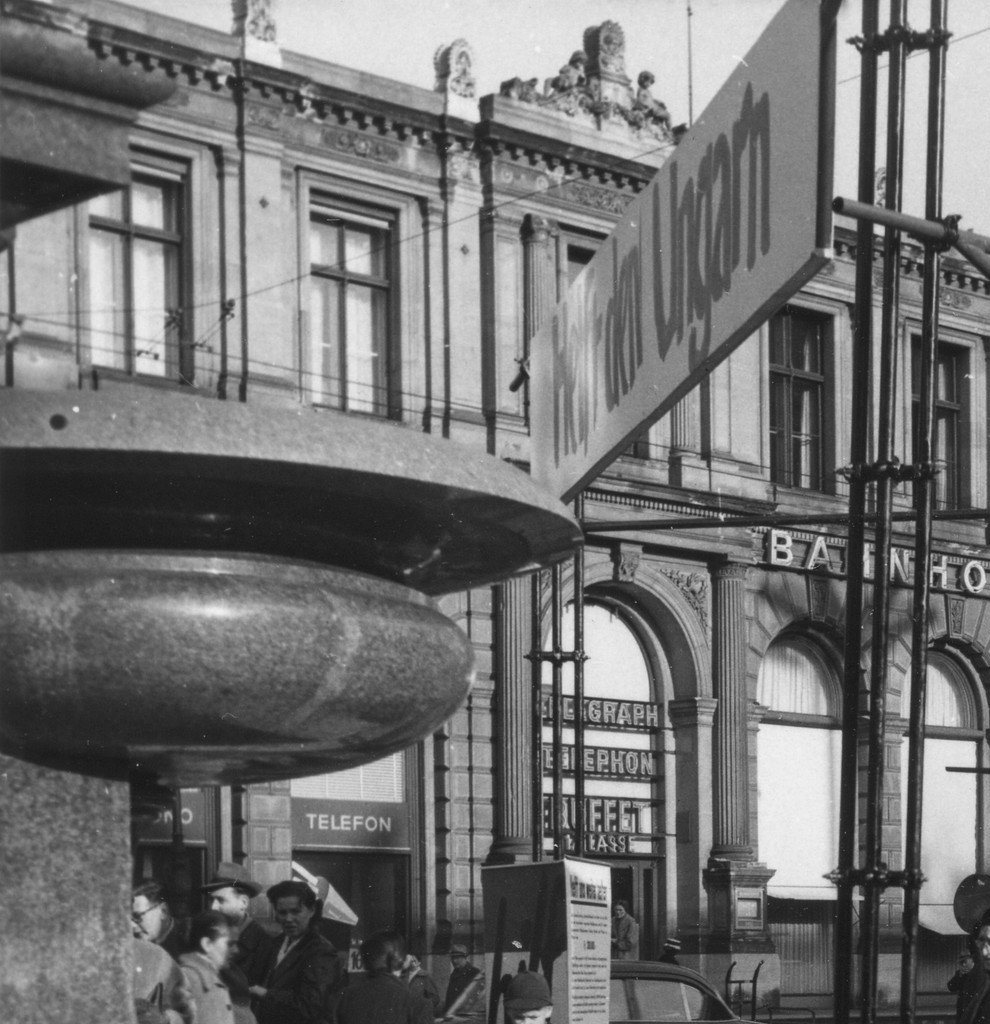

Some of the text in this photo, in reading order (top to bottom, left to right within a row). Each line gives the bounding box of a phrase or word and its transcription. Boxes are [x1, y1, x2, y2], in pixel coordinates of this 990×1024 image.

[604, 236, 643, 413] den
[652, 81, 771, 374] Ungarn
[305, 813, 391, 832] TELEFON
